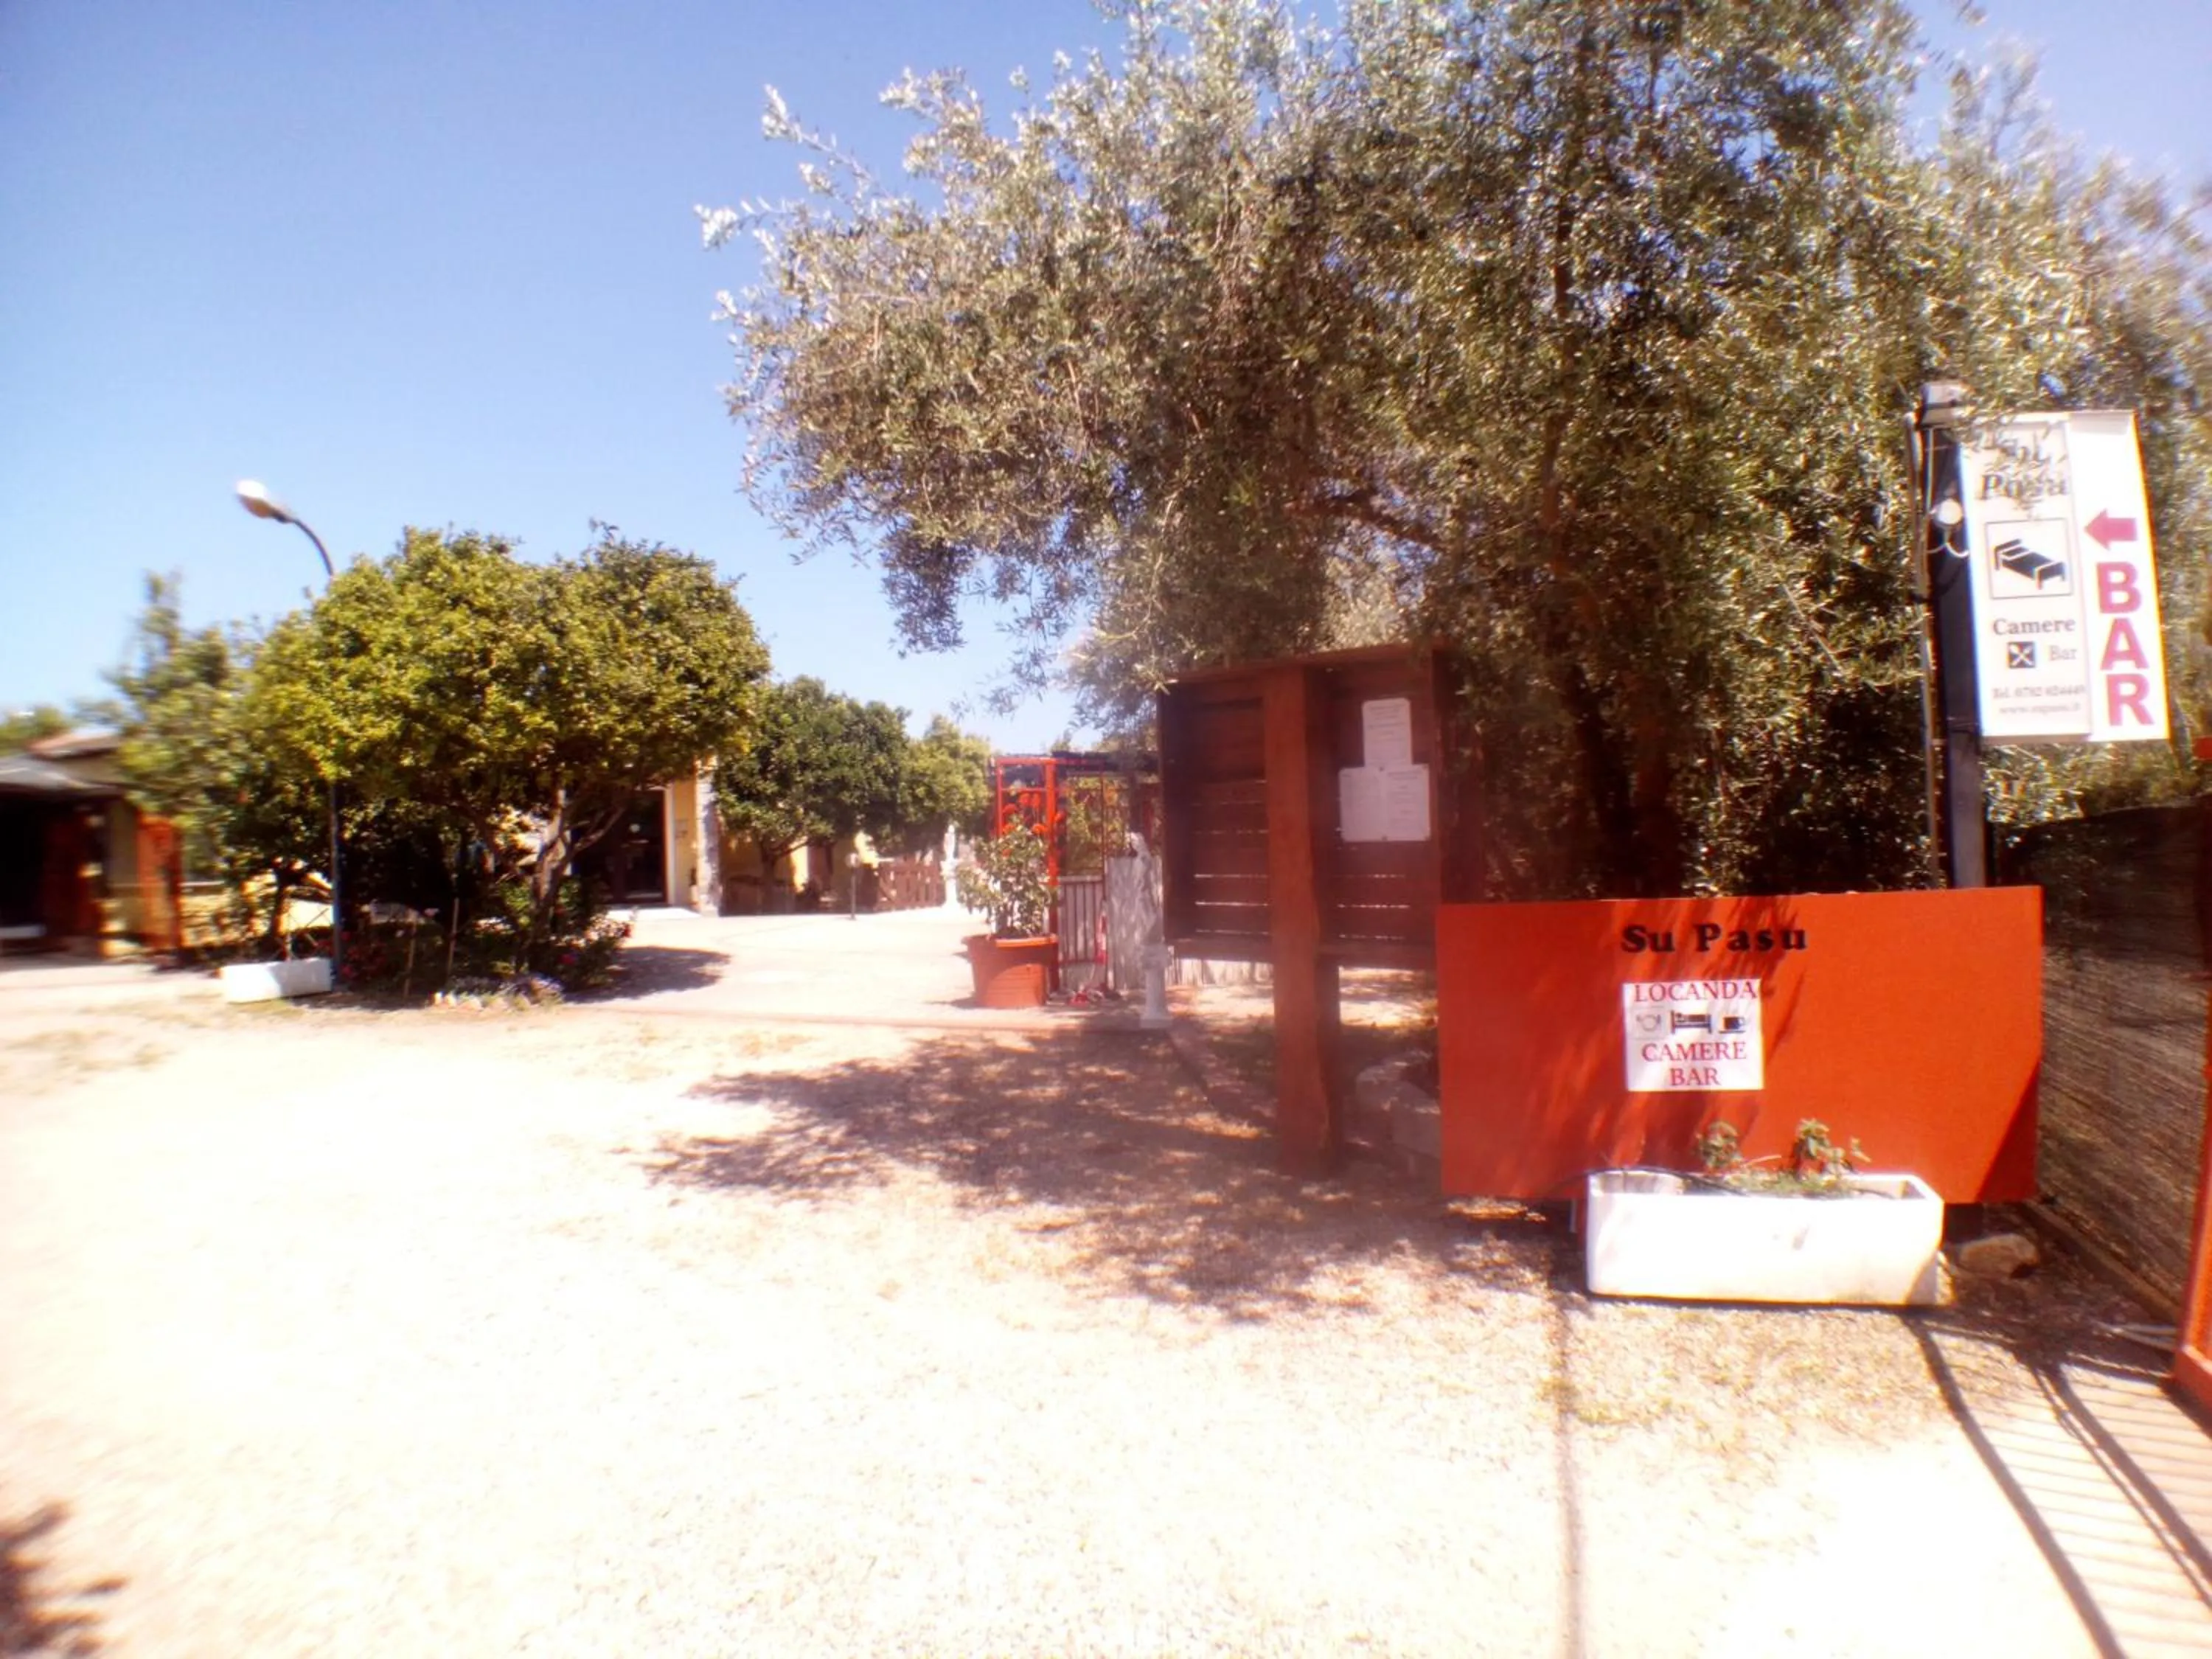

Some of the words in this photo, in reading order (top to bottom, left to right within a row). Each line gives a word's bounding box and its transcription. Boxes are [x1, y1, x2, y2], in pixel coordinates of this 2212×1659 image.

[1992, 618, 2076, 636] Camere
[2050, 644, 2077, 661] Bar
[2096, 561, 2154, 726] BAR
[1621, 925, 1675, 953] Su
[1694, 923, 1807, 952] Pasu
[1634, 981, 1758, 1002] LOCANDA
[1641, 1042, 1747, 1062] CAMERE
[1669, 1068, 1722, 1087] BAR
